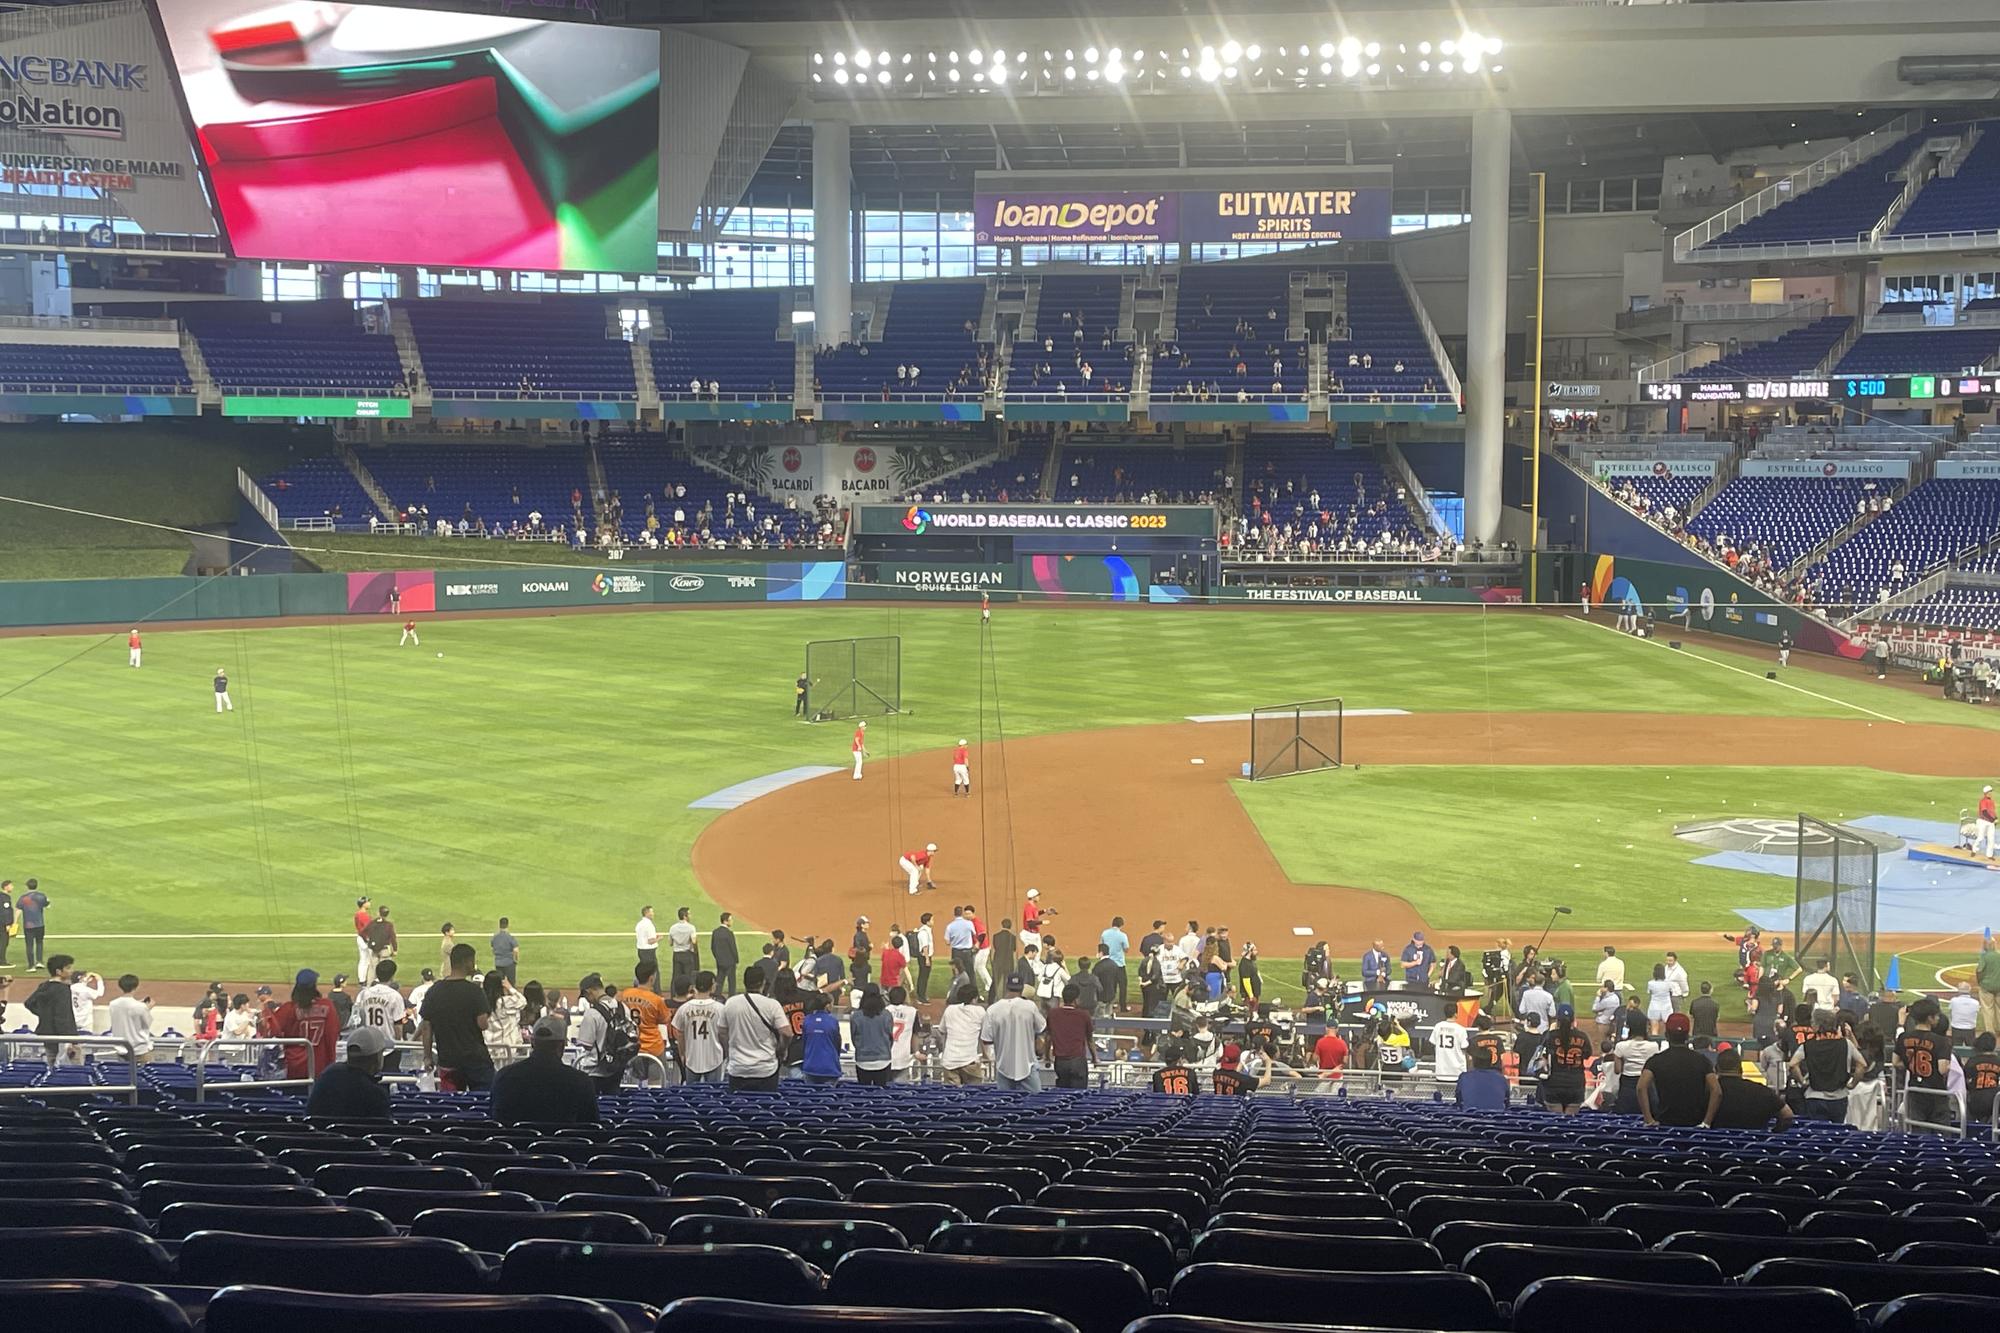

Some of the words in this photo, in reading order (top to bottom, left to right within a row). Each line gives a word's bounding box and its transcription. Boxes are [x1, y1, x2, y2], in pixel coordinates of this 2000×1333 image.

[2, 154, 98, 171] UNIVERSITY
[103, 159, 122, 172] OF
[128, 161, 180, 176] MIAMI
[2, 168, 64, 185] HEALTH
[68, 171, 134, 189] SYSTEM
[1218, 191, 1352, 215] CUTWATER
[994, 199, 1160, 232] loanDepot
[1257, 218, 1311, 232] SPIRITS
[90, 228, 112, 242] 42
[1648, 384, 1681, 399] 4:24
[1700, 384, 1733, 392] MARLINS
[1747, 382, 1788, 399] 50/50
[1789, 382, 1829, 397] RAFFLE
[1847, 381, 1857, 397] $
[1860, 381, 1885, 395] 500
[1668, 464, 1712, 472] JALISCO
[1767, 465, 1822, 473] ESTRELLA
[1838, 465, 1883, 473] JALISCO
[932, 514, 987, 528] WORLD
[988, 514, 1063, 528] BASEBALL
[1066, 515, 1128, 528] CLASSIC
[1130, 515, 1167, 528] 2023
[895, 571, 1003, 584] NORWEGIAN
[522, 581, 569, 593] KONAMI
[1246, 589, 1272, 600] THE
[1274, 589, 1334, 601] FESTIVAL
[1335, 590, 1353, 600] OF
[1355, 590, 1421, 601] BASEBALL
[1387, 1001, 1417, 1009] WORLD
[368, 1007, 384, 1027] 16
[692, 1020, 709, 1040] 14
[1439, 1035, 1454, 1049] 13
[1381, 1049, 1398, 1062] 55
